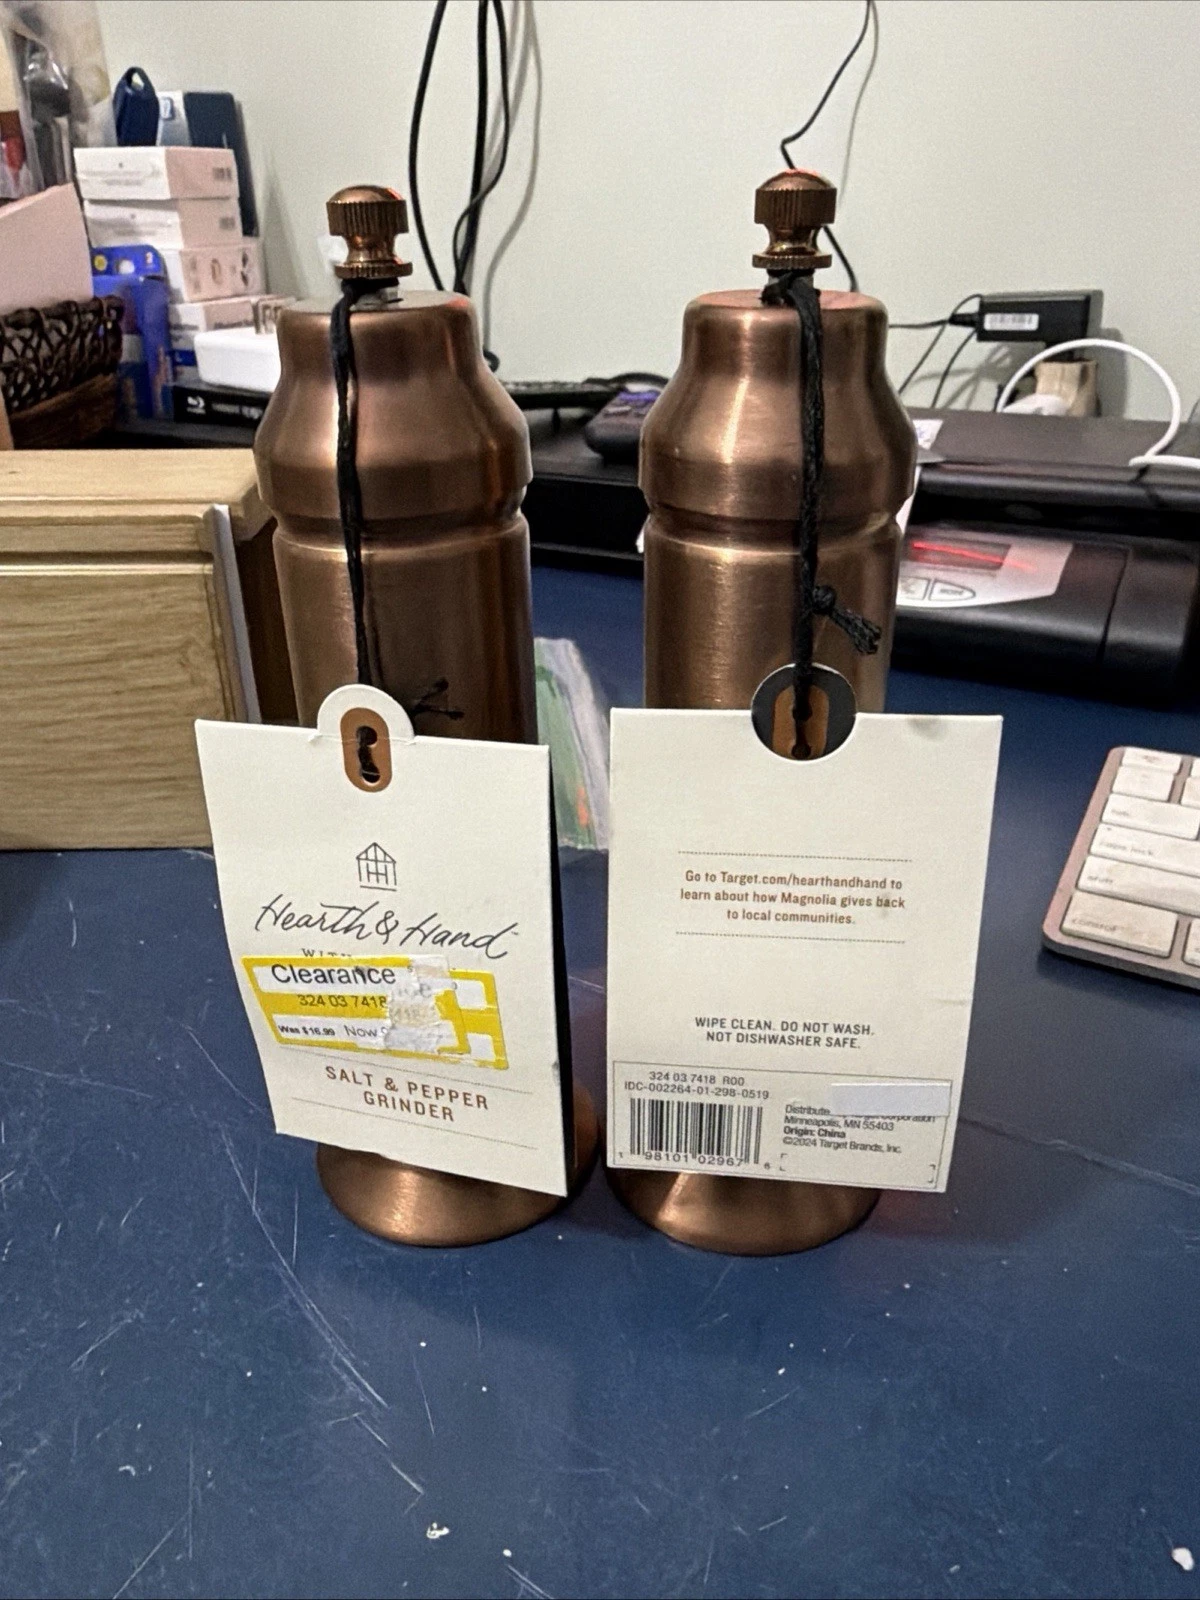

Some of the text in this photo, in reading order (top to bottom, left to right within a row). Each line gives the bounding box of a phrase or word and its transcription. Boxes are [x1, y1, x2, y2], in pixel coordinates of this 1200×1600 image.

[685, 870, 902, 890] Go to Target.com/hearthandhand to
[680, 889, 905, 908] learn about how Magnolia gives back
[255, 894, 379, 939] Hearth
[376, 911, 399, 944] &
[727, 909, 855, 924] to local communities.
[271, 964, 396, 985] Clearance
[297, 994, 325, 1008] 324
[328, 995, 348, 1008] 03
[278, 1025, 300, 1035] Was
[302, 1026, 335, 1036] $16.99
[344, 1025, 378, 1037] Now
[695, 1017, 875, 1035] WIPE CLEAN. DO NOT WASH.
[706, 1031, 860, 1049] NOT DISHWASHER SAFE.
[649, 1071, 669, 1081] 324
[673, 1073, 687, 1082] 03
[691, 1074, 716, 1084] 7418
[325, 1065, 488, 1110] SALT & PEPPER
[624, 1081, 769, 1100] IDC-002264-01-298-0519
[363, 1091, 455, 1122] GRINDER
[785, 1104, 831, 1115] Distribute
[784, 1115, 841, 1128] Minneapolis,
[844, 1120, 860, 1129] MN
[863, 1120, 894, 1131] 55403
[783, 1126, 846, 1138] Origin: China
[820, 1139, 847, 1150] Target
[645, 1152, 689, 1163] 98101
[698, 1153, 744, 1167] 02967
